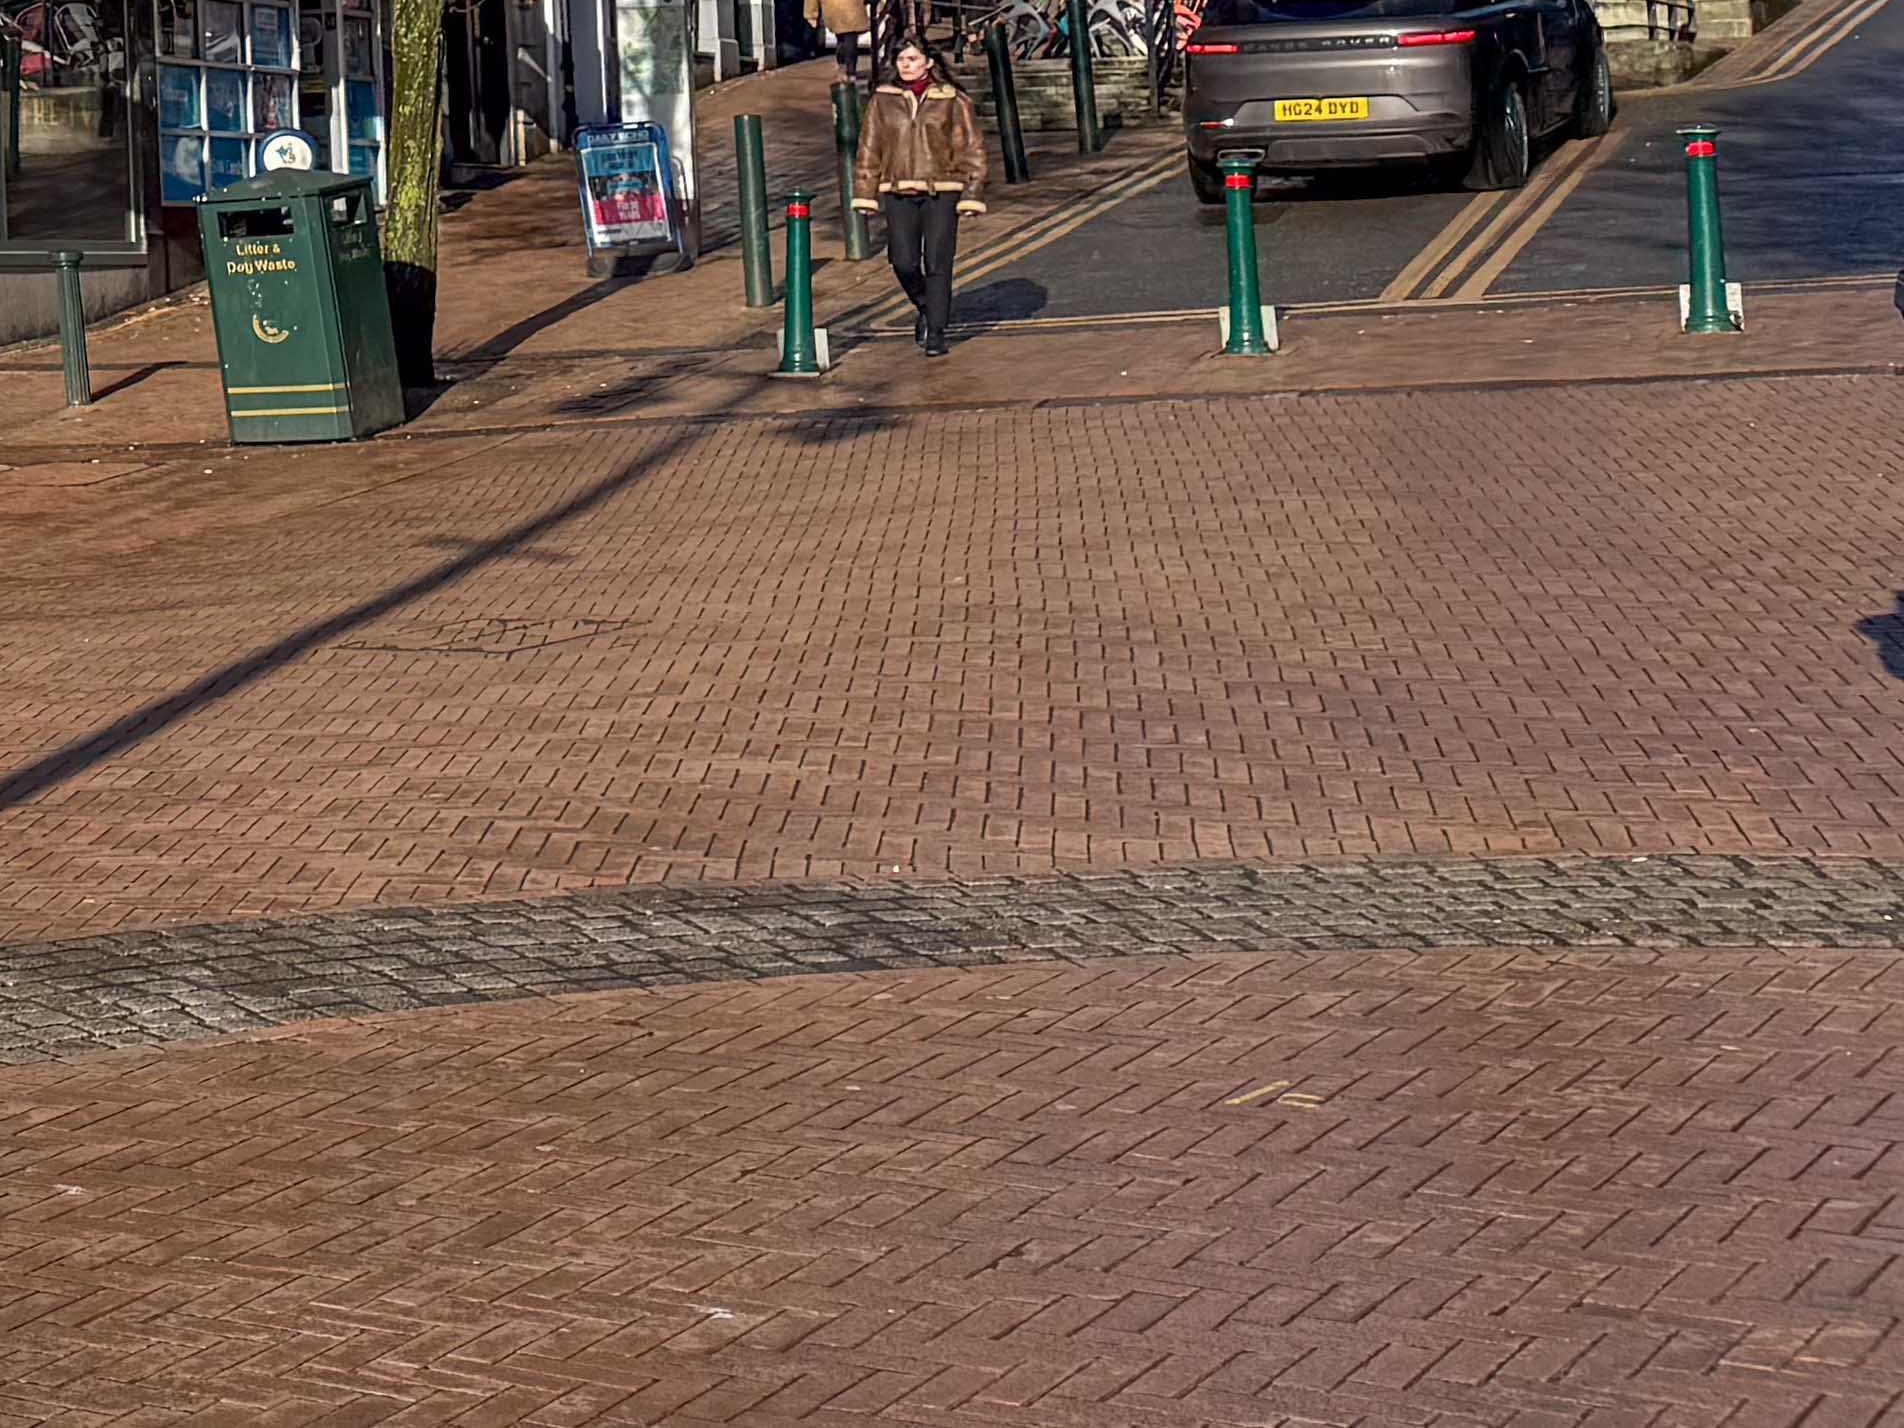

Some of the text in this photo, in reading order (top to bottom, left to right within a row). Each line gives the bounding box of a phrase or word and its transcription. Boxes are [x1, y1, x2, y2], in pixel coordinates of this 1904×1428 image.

[236, 243, 269, 256] Litter
[226, 258, 296, 276] Dog Waste
